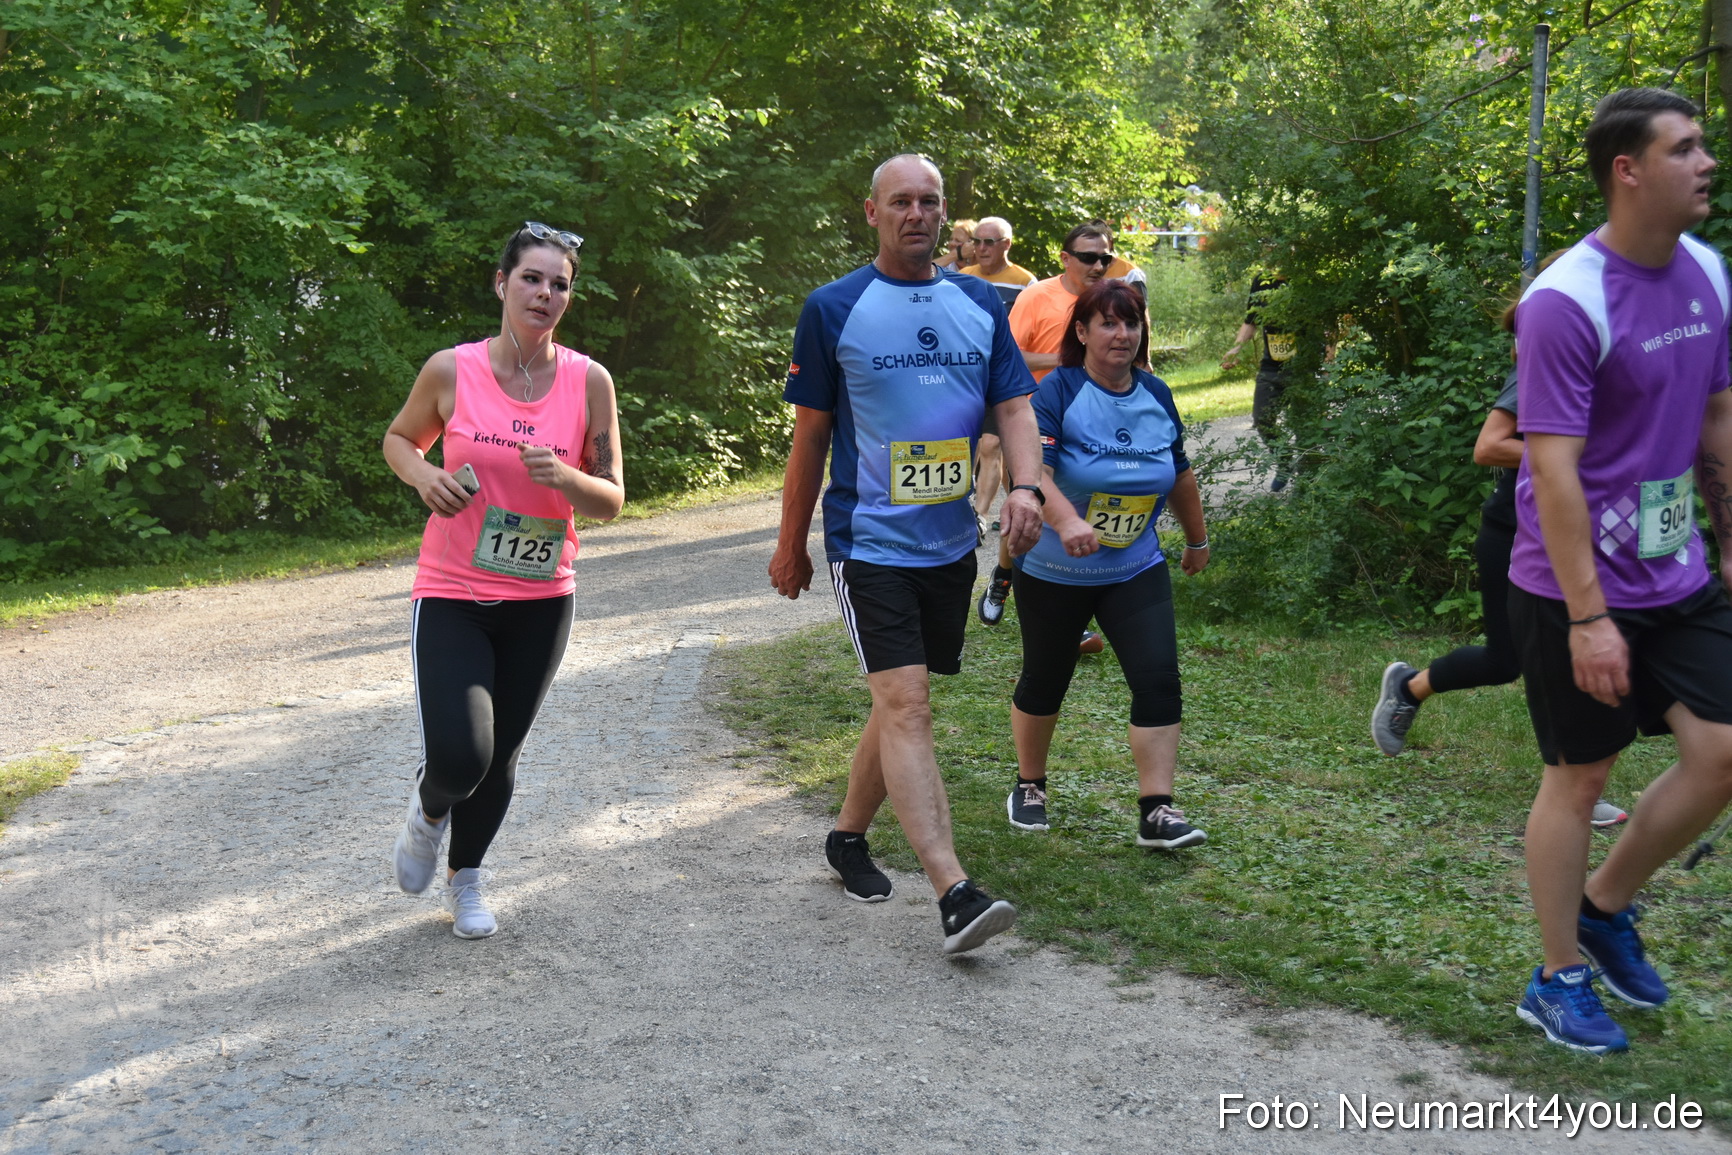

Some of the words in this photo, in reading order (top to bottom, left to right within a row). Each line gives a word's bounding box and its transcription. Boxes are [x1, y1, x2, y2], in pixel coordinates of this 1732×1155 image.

[1641, 336, 1663, 353] WIR
[1683, 322, 1711, 338] LILA.
[872, 351, 983, 371] SCHABMÜLLER
[918, 374, 946, 385] TEAM
[512, 419, 536, 436] Die
[473, 431, 568, 457] Kieferorden
[901, 462, 962, 487] 2113
[1115, 461, 1140, 470] TEAM
[1093, 512, 1146, 533] 2112
[1660, 499, 1687, 534] 904
[491, 532, 554, 563] 1125
[493, 555, 514, 565] Schön
[515, 560, 542, 569] Johanna
[1046, 555, 1151, 574] www.schabmueller.de
